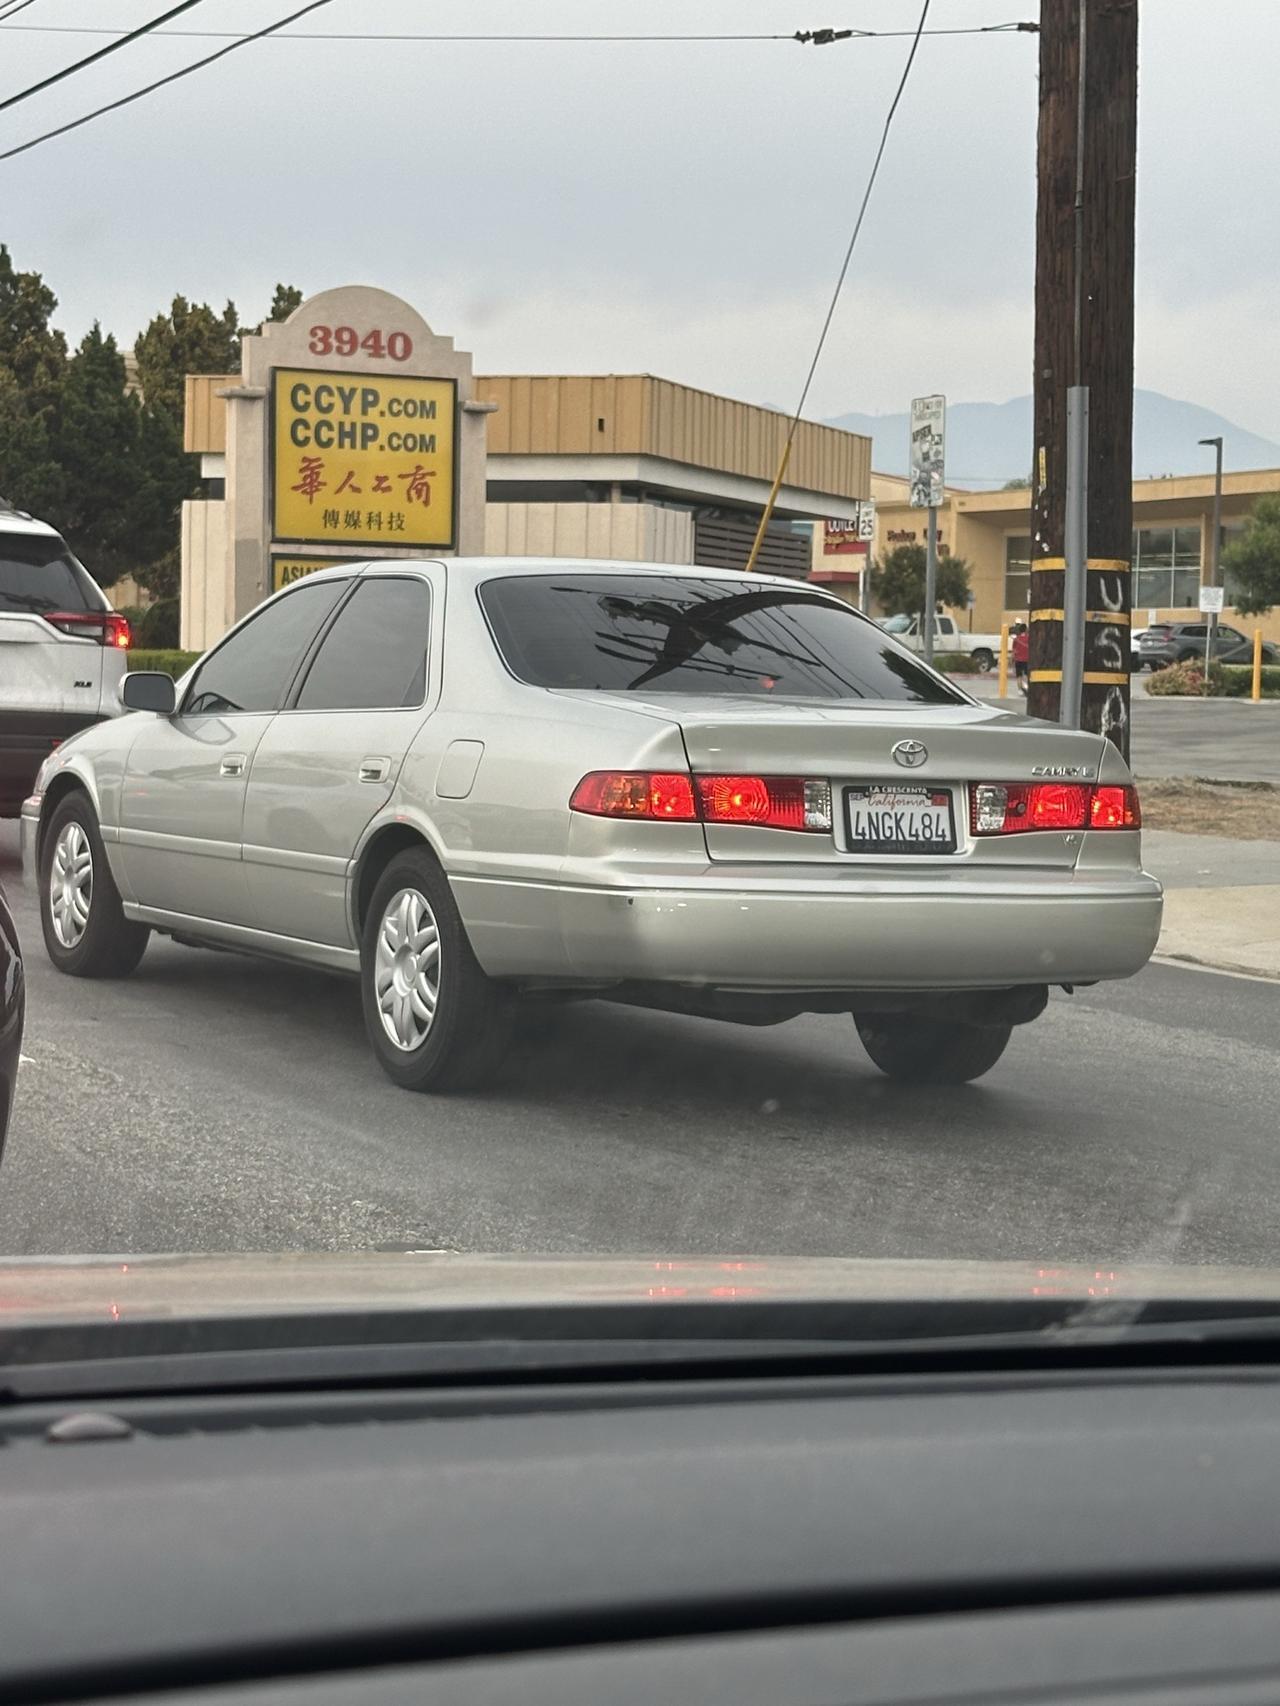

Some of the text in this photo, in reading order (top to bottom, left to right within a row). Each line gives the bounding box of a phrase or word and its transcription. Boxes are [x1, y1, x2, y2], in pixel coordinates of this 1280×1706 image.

[308, 325, 413, 361] 3940
[290, 383, 437, 420] CCYP.COM
[290, 418, 437, 453] CCHP.COM
[291, 456, 438, 508] 華人工商
[322, 508, 406, 532] 傳媒科技
[861, 519, 873, 536] 25
[1031, 766, 1081, 777] CAMRY
[867, 794, 931, 810] California
[869, 785, 928, 794] LA CRESCENTA
[855, 810, 947, 842] 4NGK484
